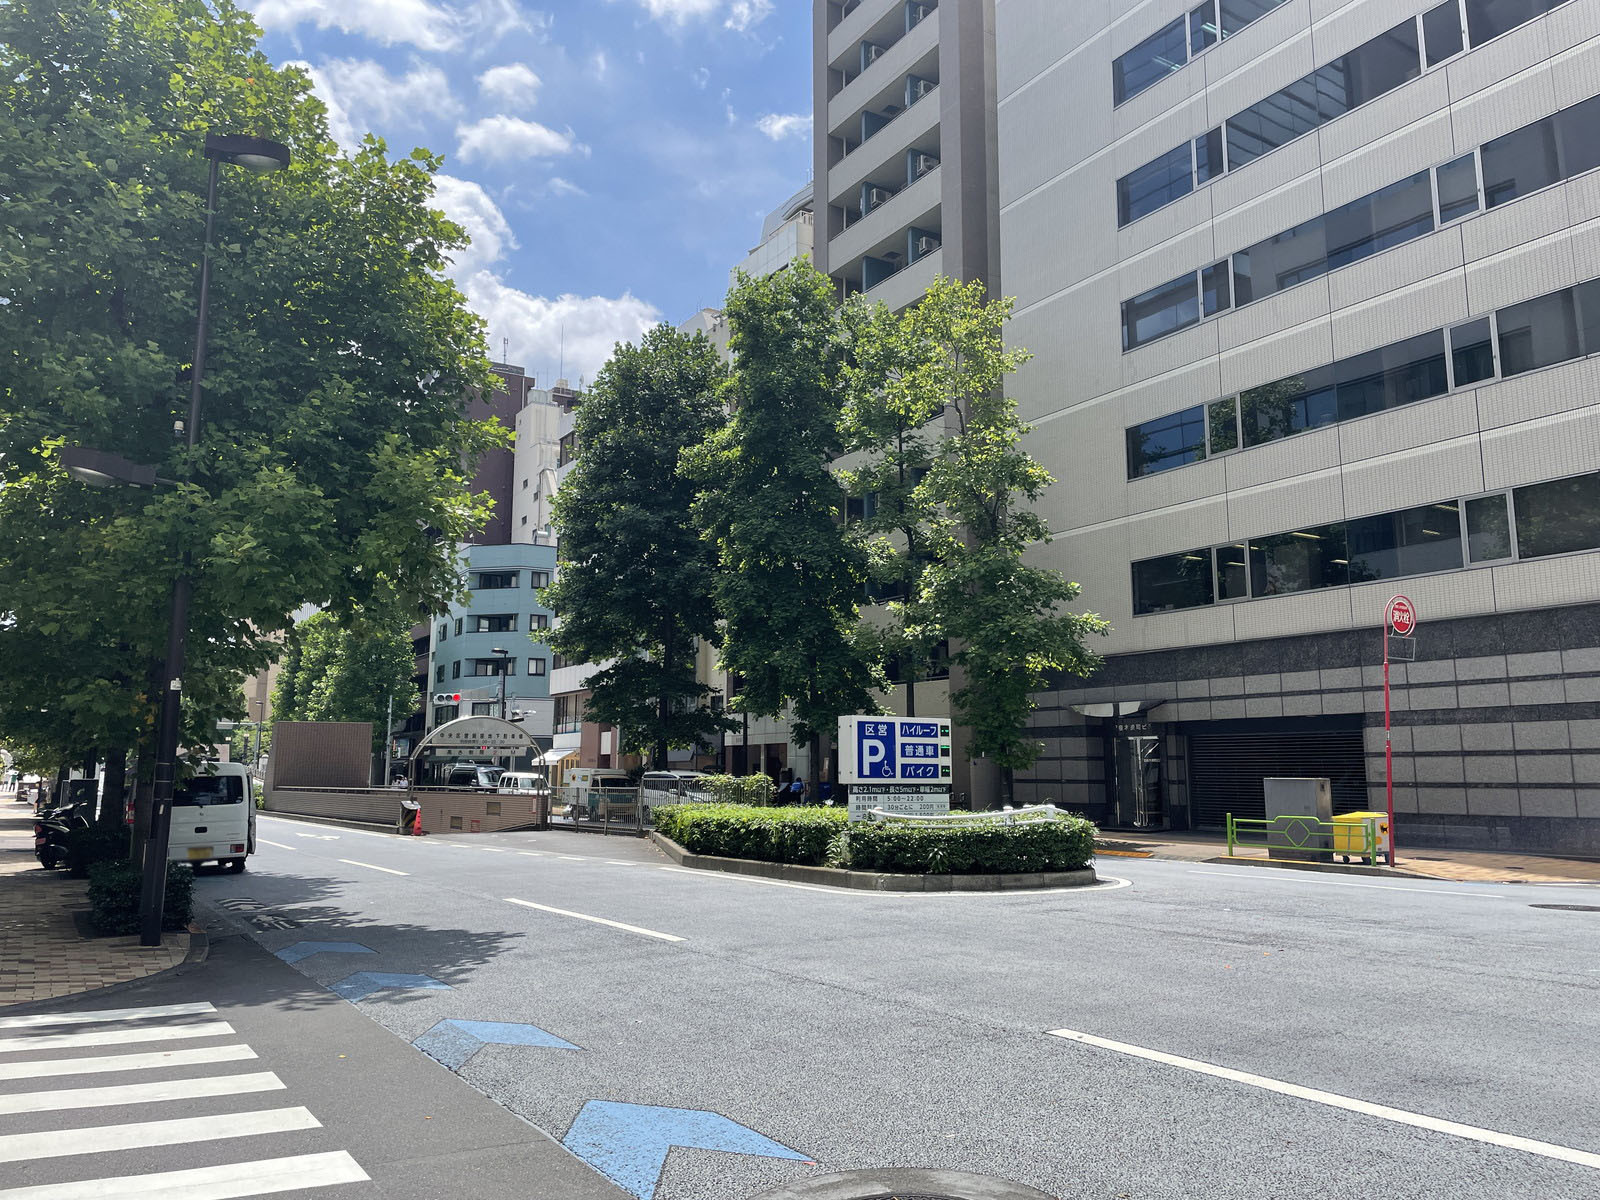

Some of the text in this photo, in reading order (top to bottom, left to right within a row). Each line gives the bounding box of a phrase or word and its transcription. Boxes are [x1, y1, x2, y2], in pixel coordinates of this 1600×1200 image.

[865, 724, 888, 736] 区営
[902, 725, 937, 736] ハイルーフ
[904, 745, 935, 756] 普通車
[862, 739, 886, 776] P
[905, 766, 934, 776] バイク
